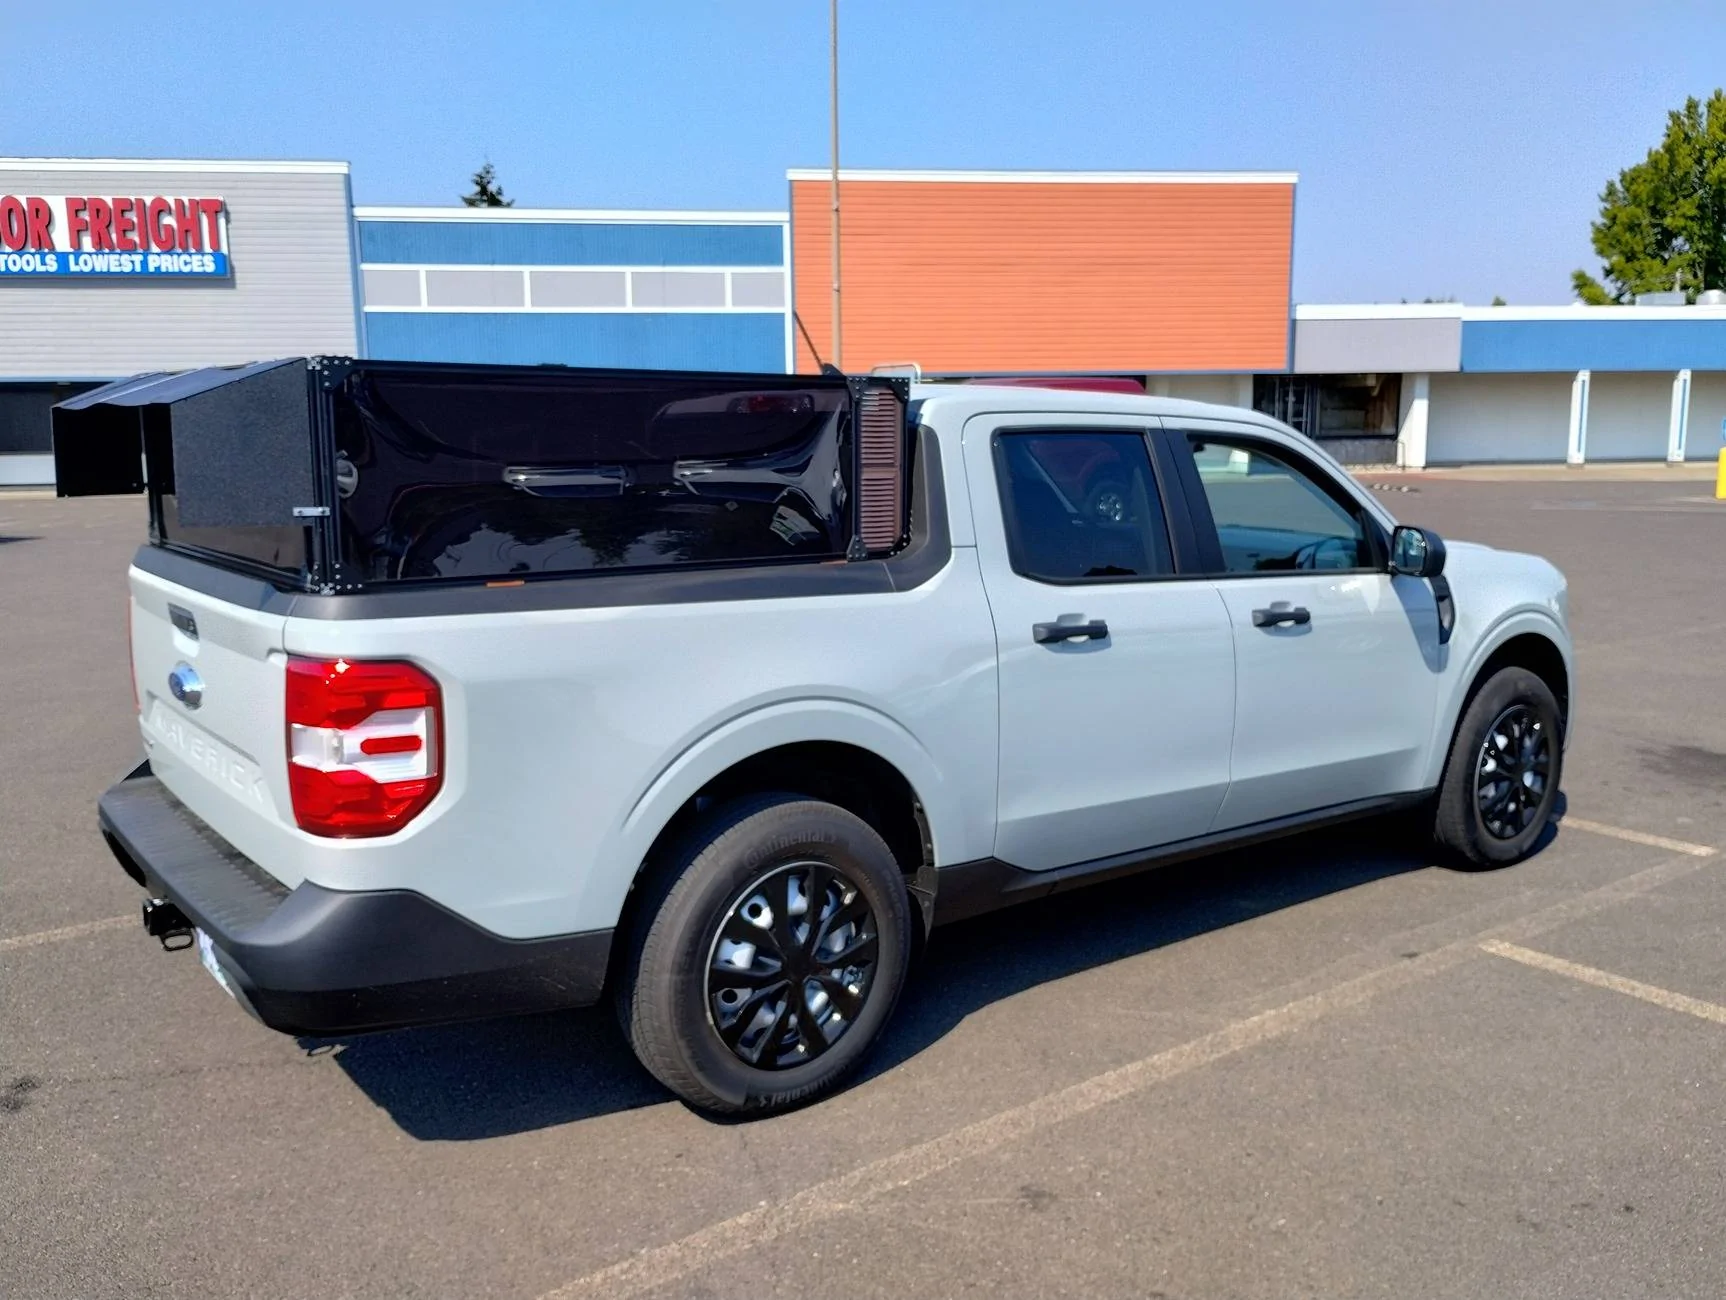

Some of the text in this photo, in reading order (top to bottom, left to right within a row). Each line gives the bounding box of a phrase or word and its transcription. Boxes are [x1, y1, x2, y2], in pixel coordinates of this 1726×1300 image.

[65, 196, 222, 252] FREIGHT
[0, 253, 216, 273] TOOLS LOWEST PRICES
